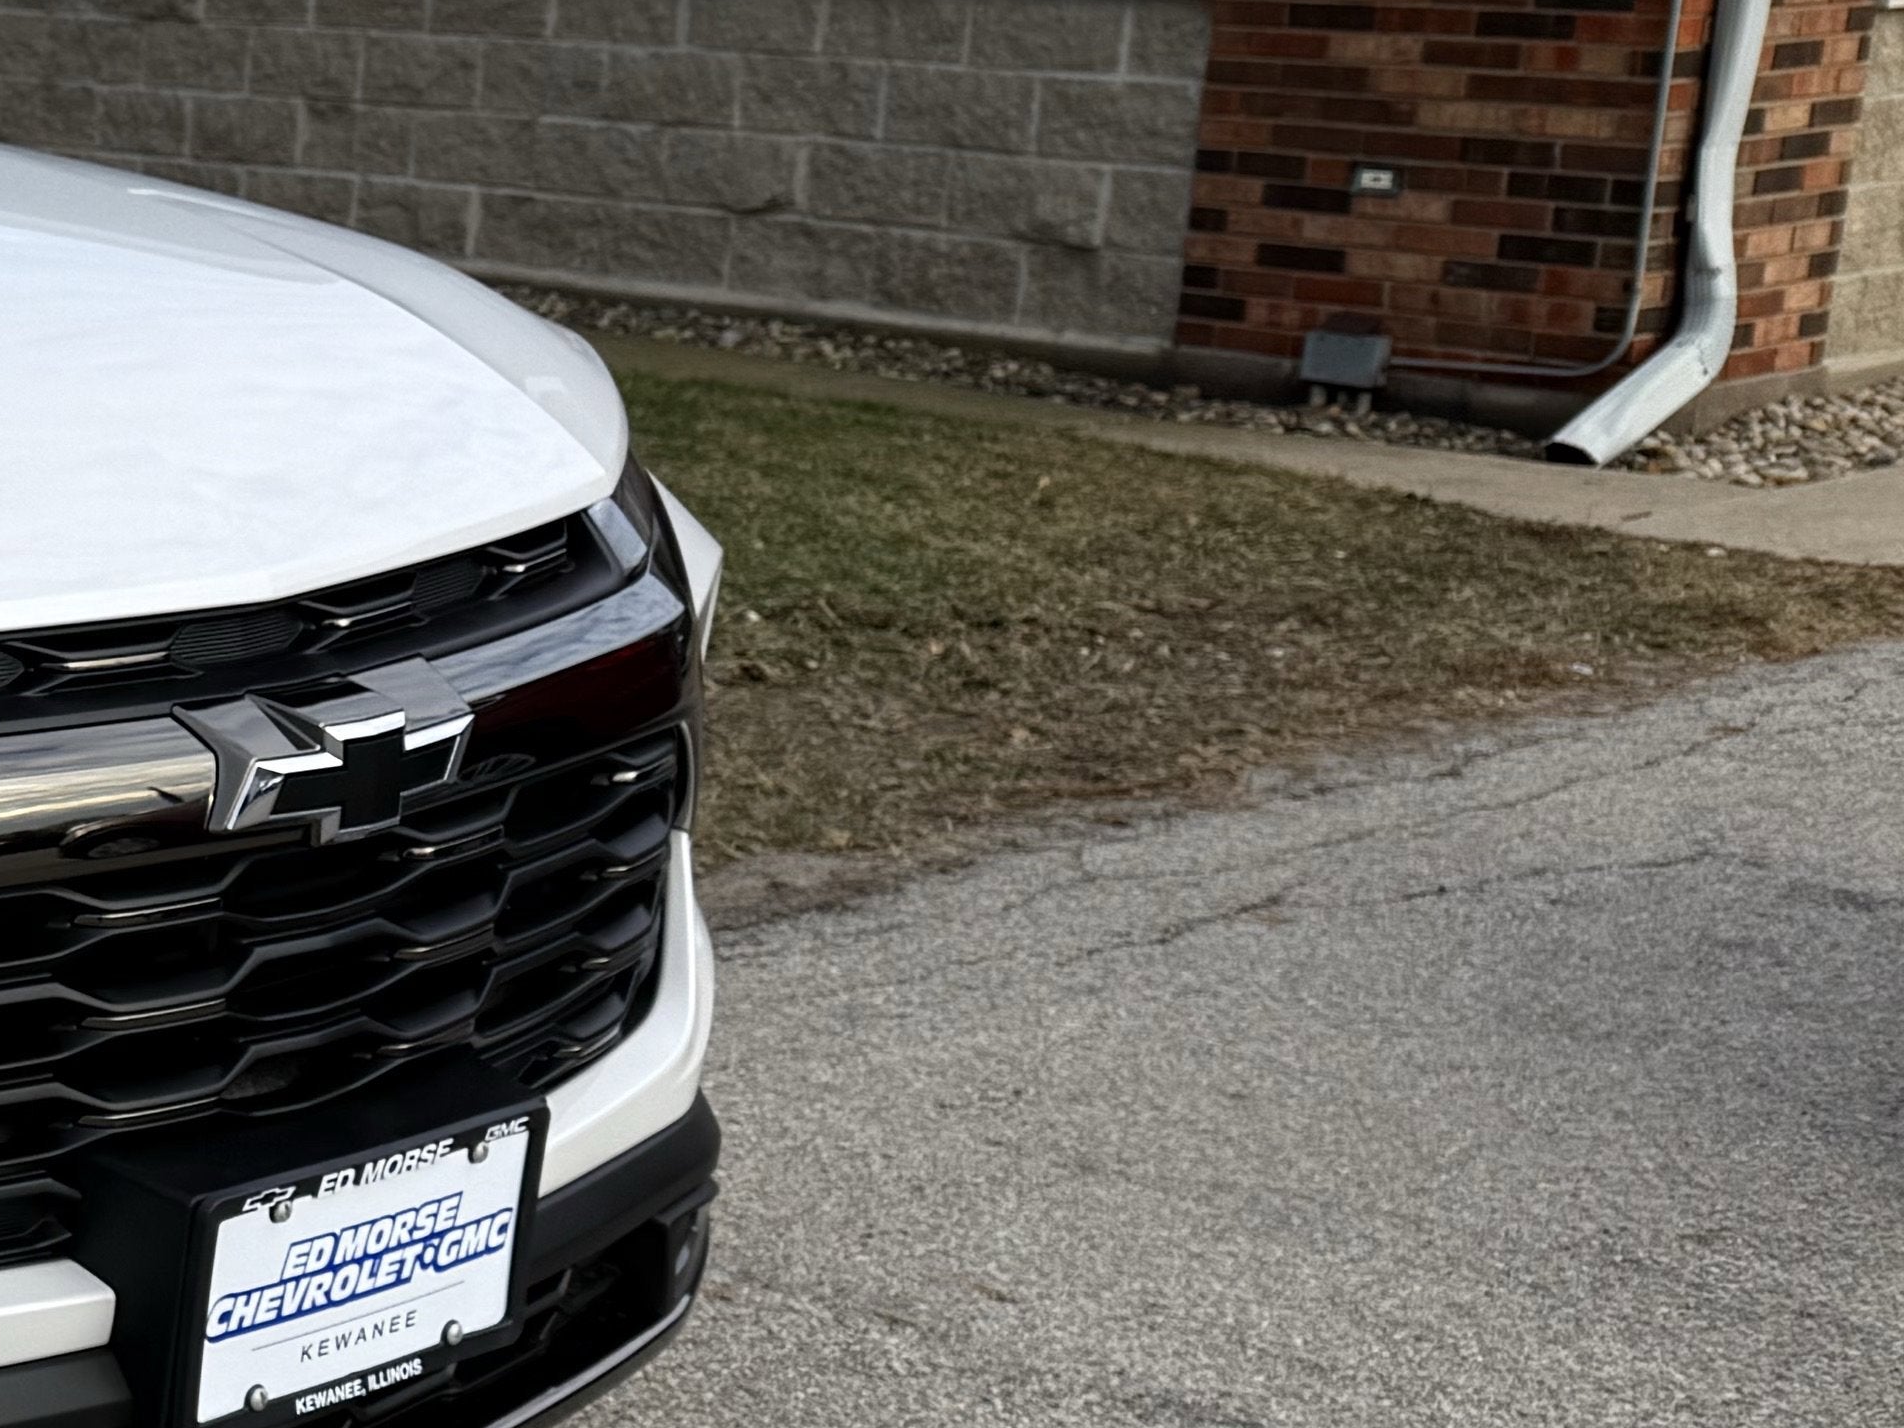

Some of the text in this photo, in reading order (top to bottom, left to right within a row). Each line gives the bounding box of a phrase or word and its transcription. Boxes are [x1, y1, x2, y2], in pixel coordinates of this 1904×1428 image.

[484, 1116, 530, 1142] GMC
[316, 1138, 454, 1198] ED MORSE
[283, 1192, 463, 1278] ED MORSE
[300, 1309, 418, 1363] KEWANEE
[295, 1357, 423, 1415] KEWANEE, ILLINOIS
